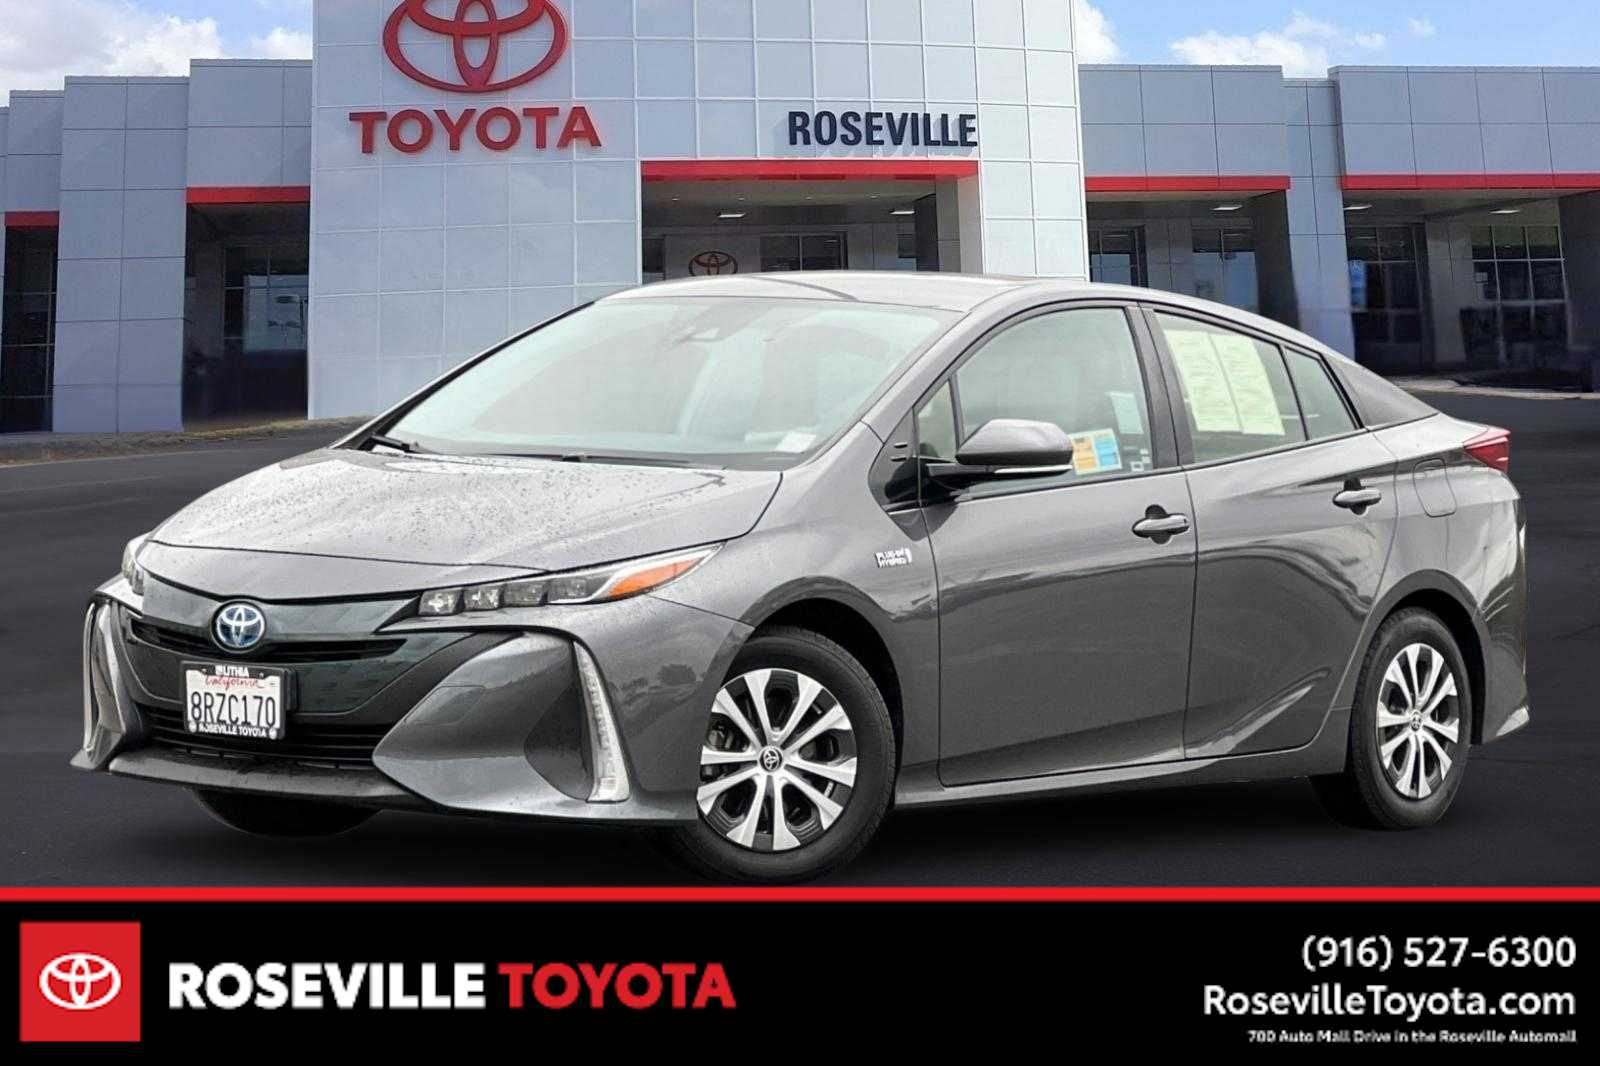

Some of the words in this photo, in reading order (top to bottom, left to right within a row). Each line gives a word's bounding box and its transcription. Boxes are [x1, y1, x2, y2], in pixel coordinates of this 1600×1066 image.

[349, 106, 602, 153] TOYOTA
[788, 111, 978, 147] ROSEVILLE
[191, 691, 275, 726] 8RZC170
[198, 722, 238, 736] ROSEVILLE
[238, 725, 268, 738] TOYOTA
